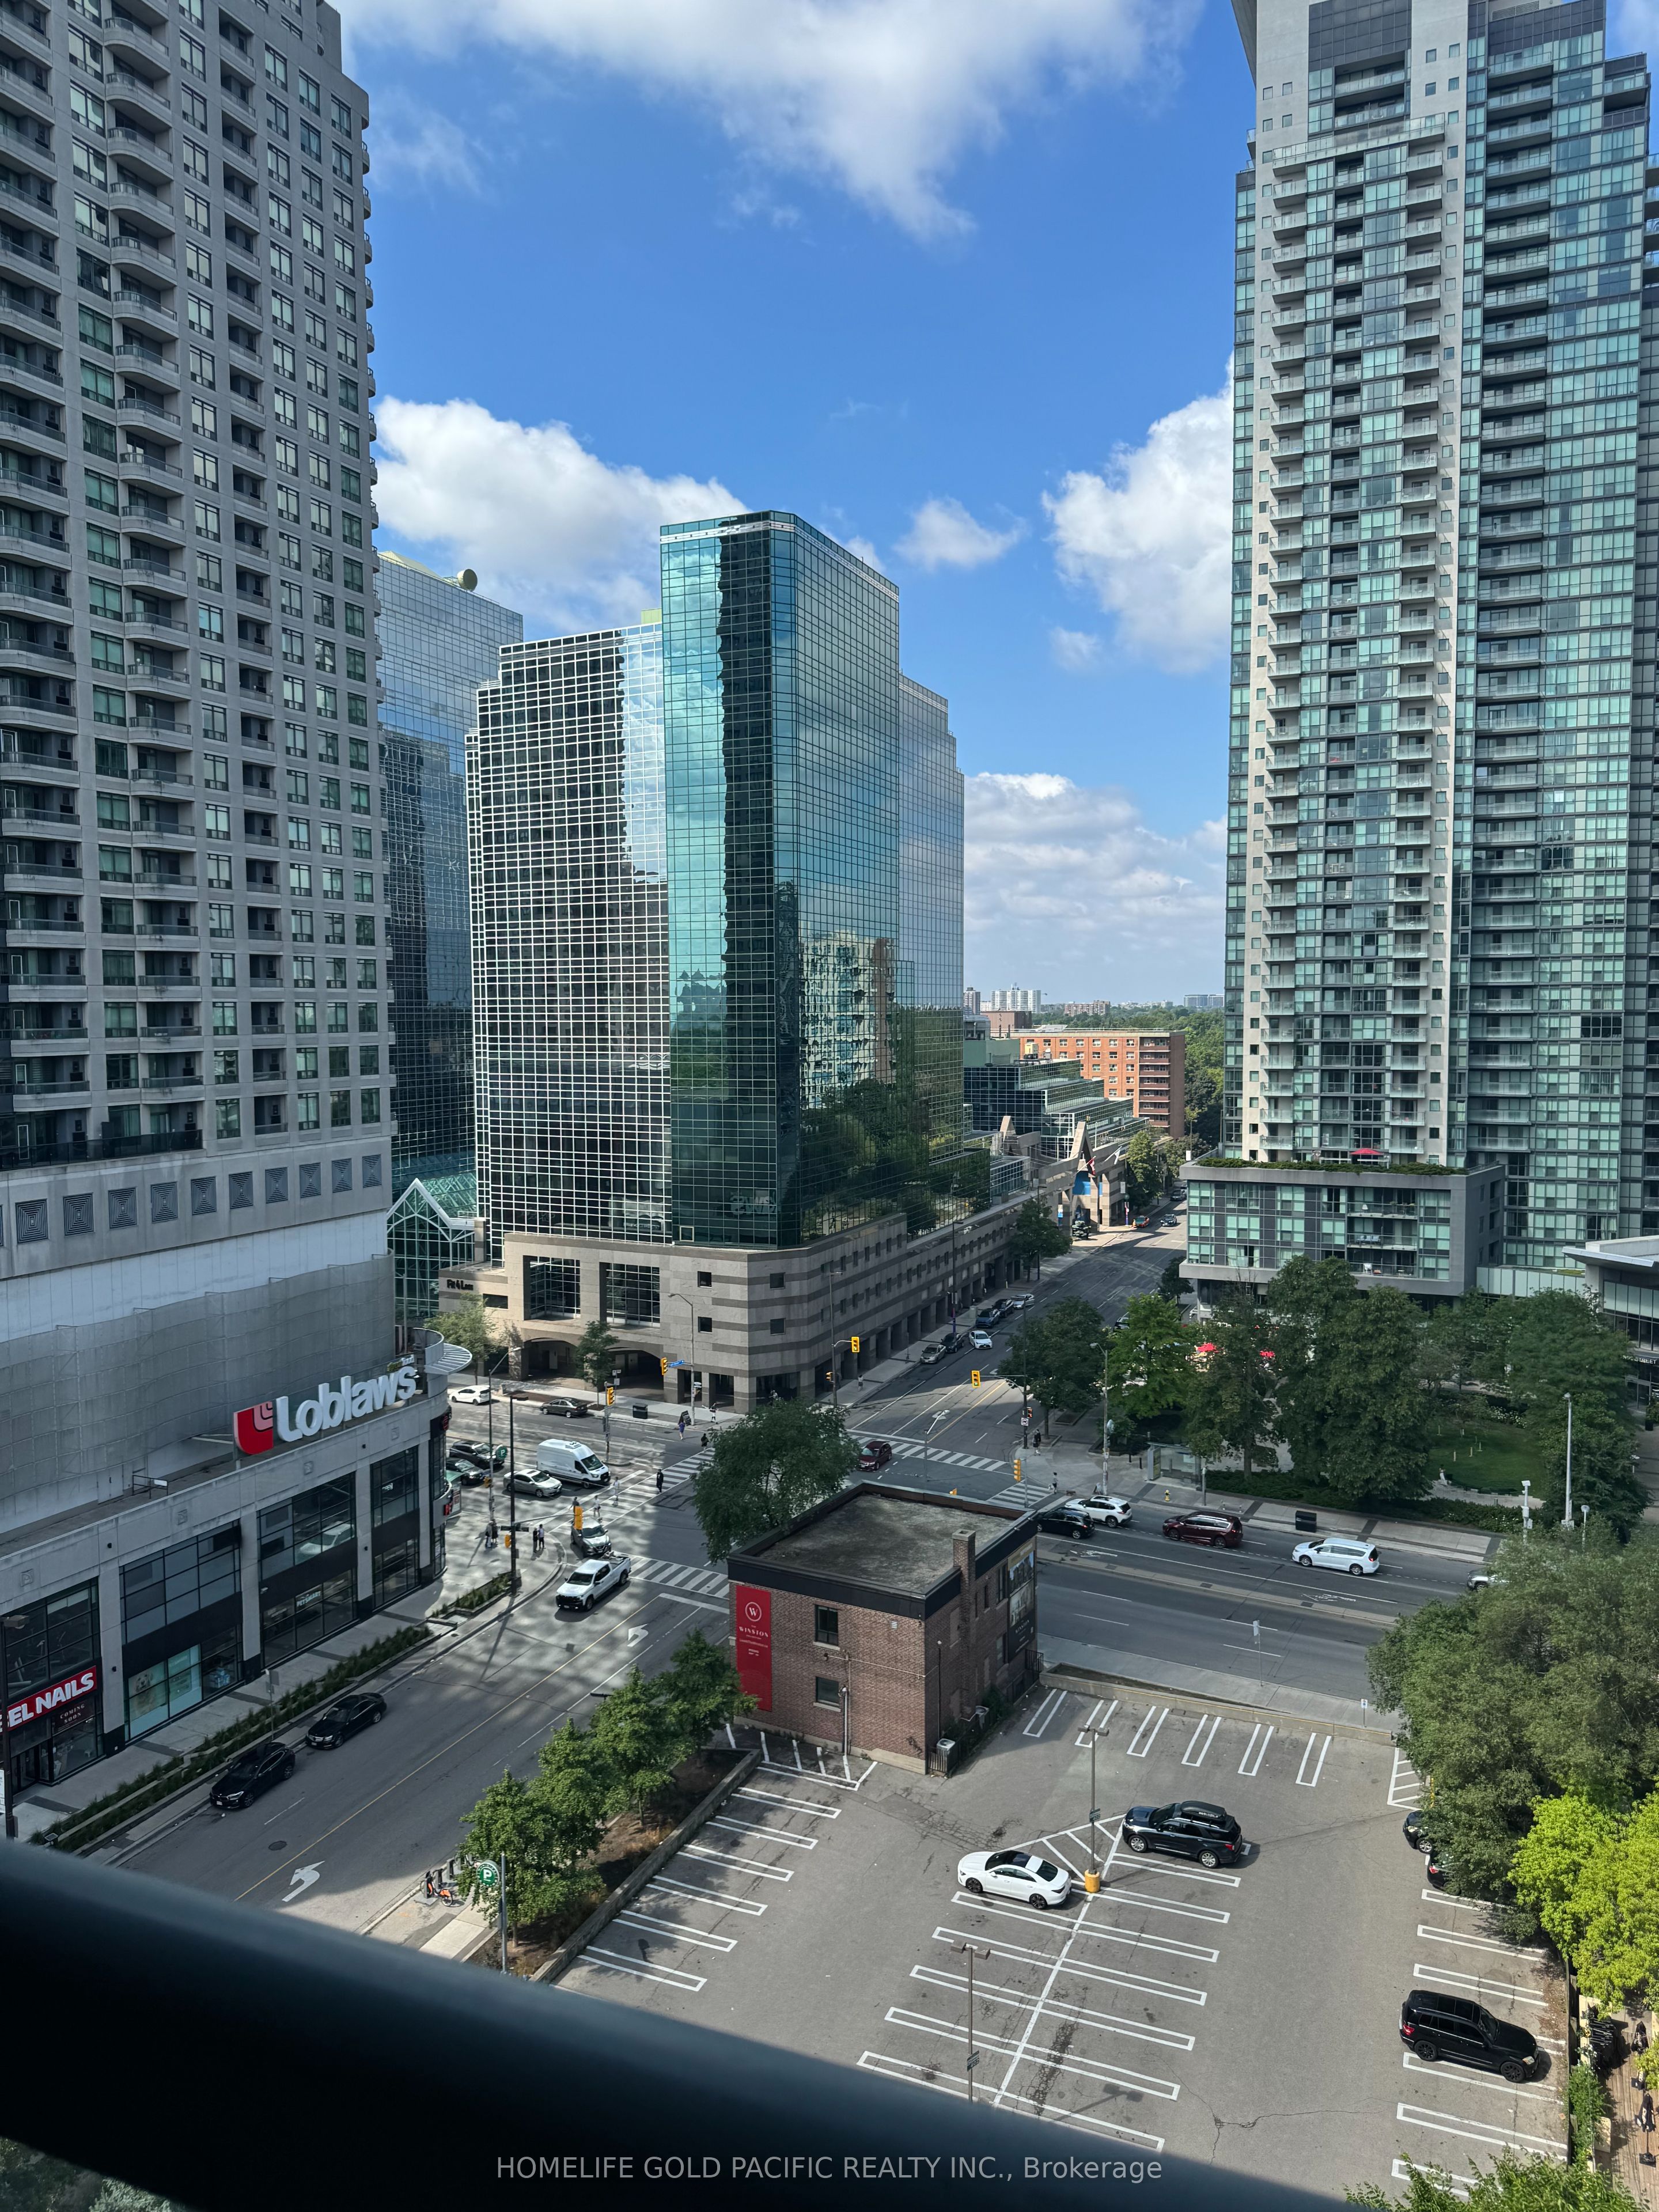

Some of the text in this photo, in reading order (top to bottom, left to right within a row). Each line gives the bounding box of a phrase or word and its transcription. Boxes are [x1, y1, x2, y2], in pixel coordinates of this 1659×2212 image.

[276, 1366, 416, 1442] Loblaws
[739, 1626, 768, 1637] WINSTON
[36, 1672, 94, 1714] NAILS
[60, 1703, 85, 1719] COMING
[64, 1713, 81, 1724] SOON
[483, 1869, 493, 1879] P
